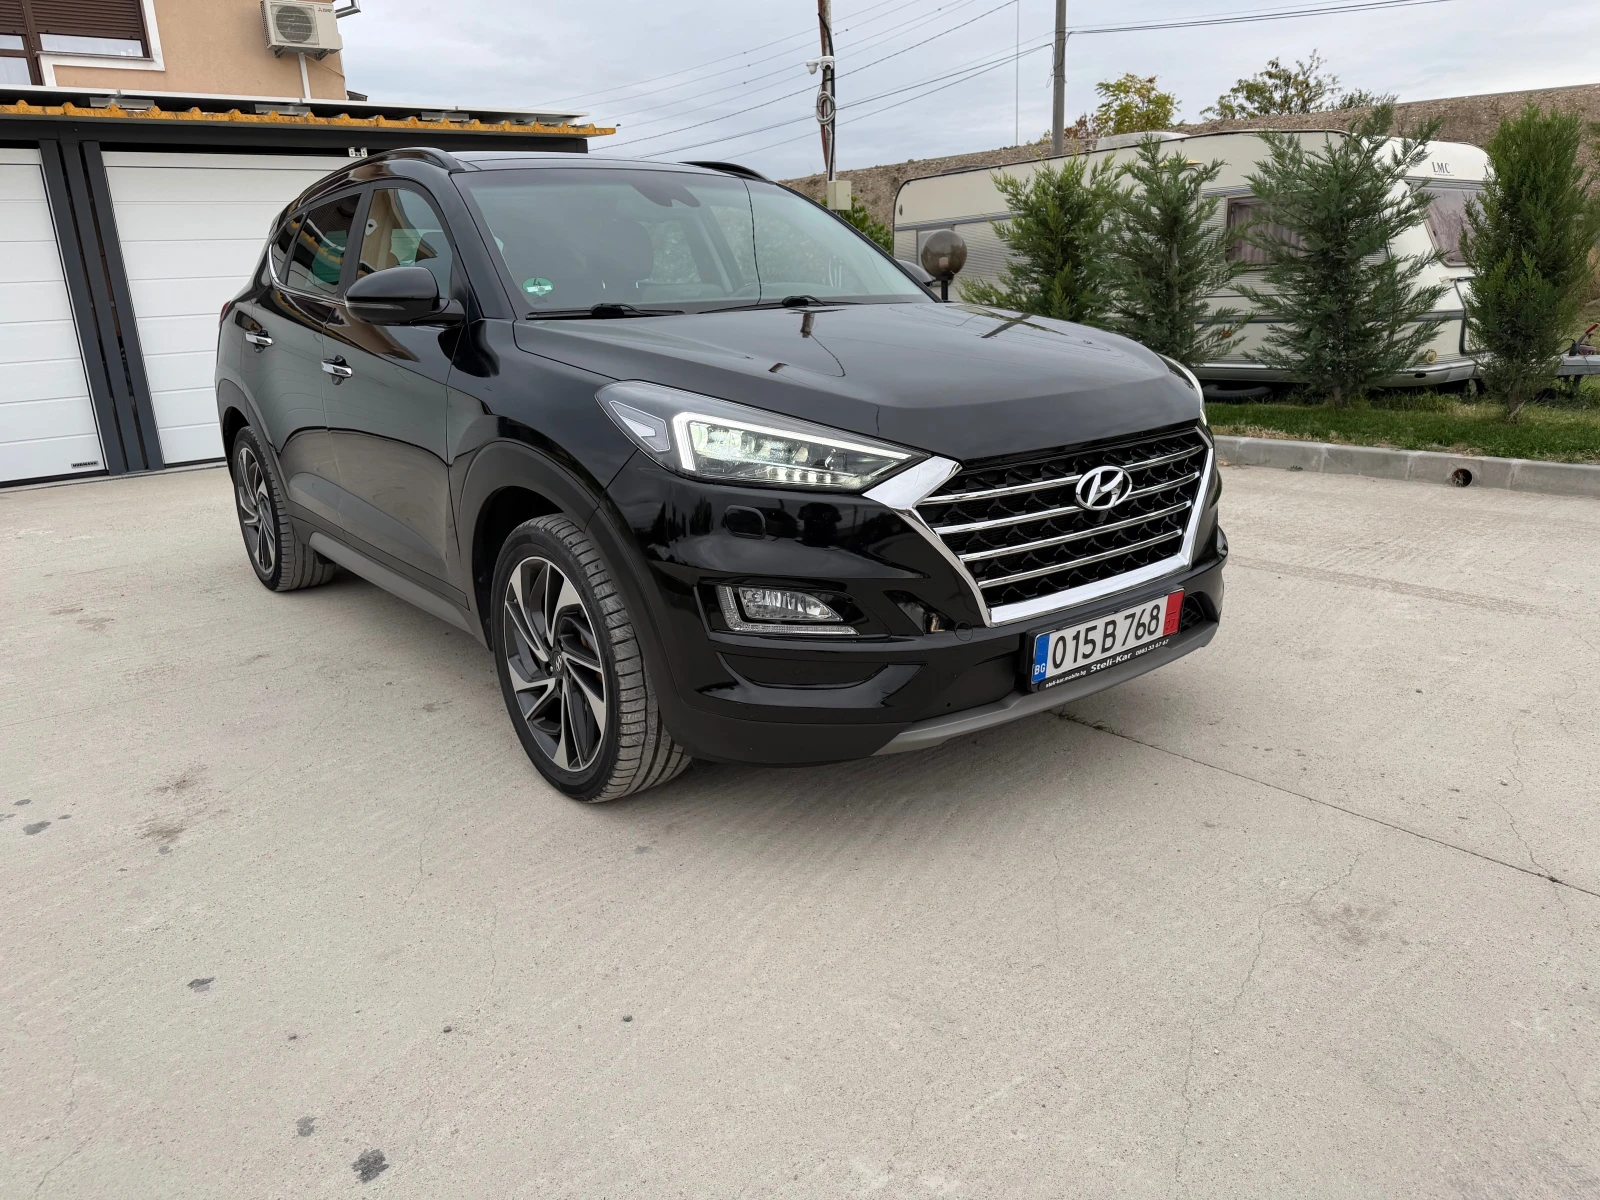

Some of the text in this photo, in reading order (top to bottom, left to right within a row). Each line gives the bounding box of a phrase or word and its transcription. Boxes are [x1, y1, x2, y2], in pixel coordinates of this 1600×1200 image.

[1431, 161, 1450, 174] LMC
[533, 277, 542, 286] 4
[1034, 662, 1046, 676] BG
[1090, 652, 1132, 673] Steli-Kar
